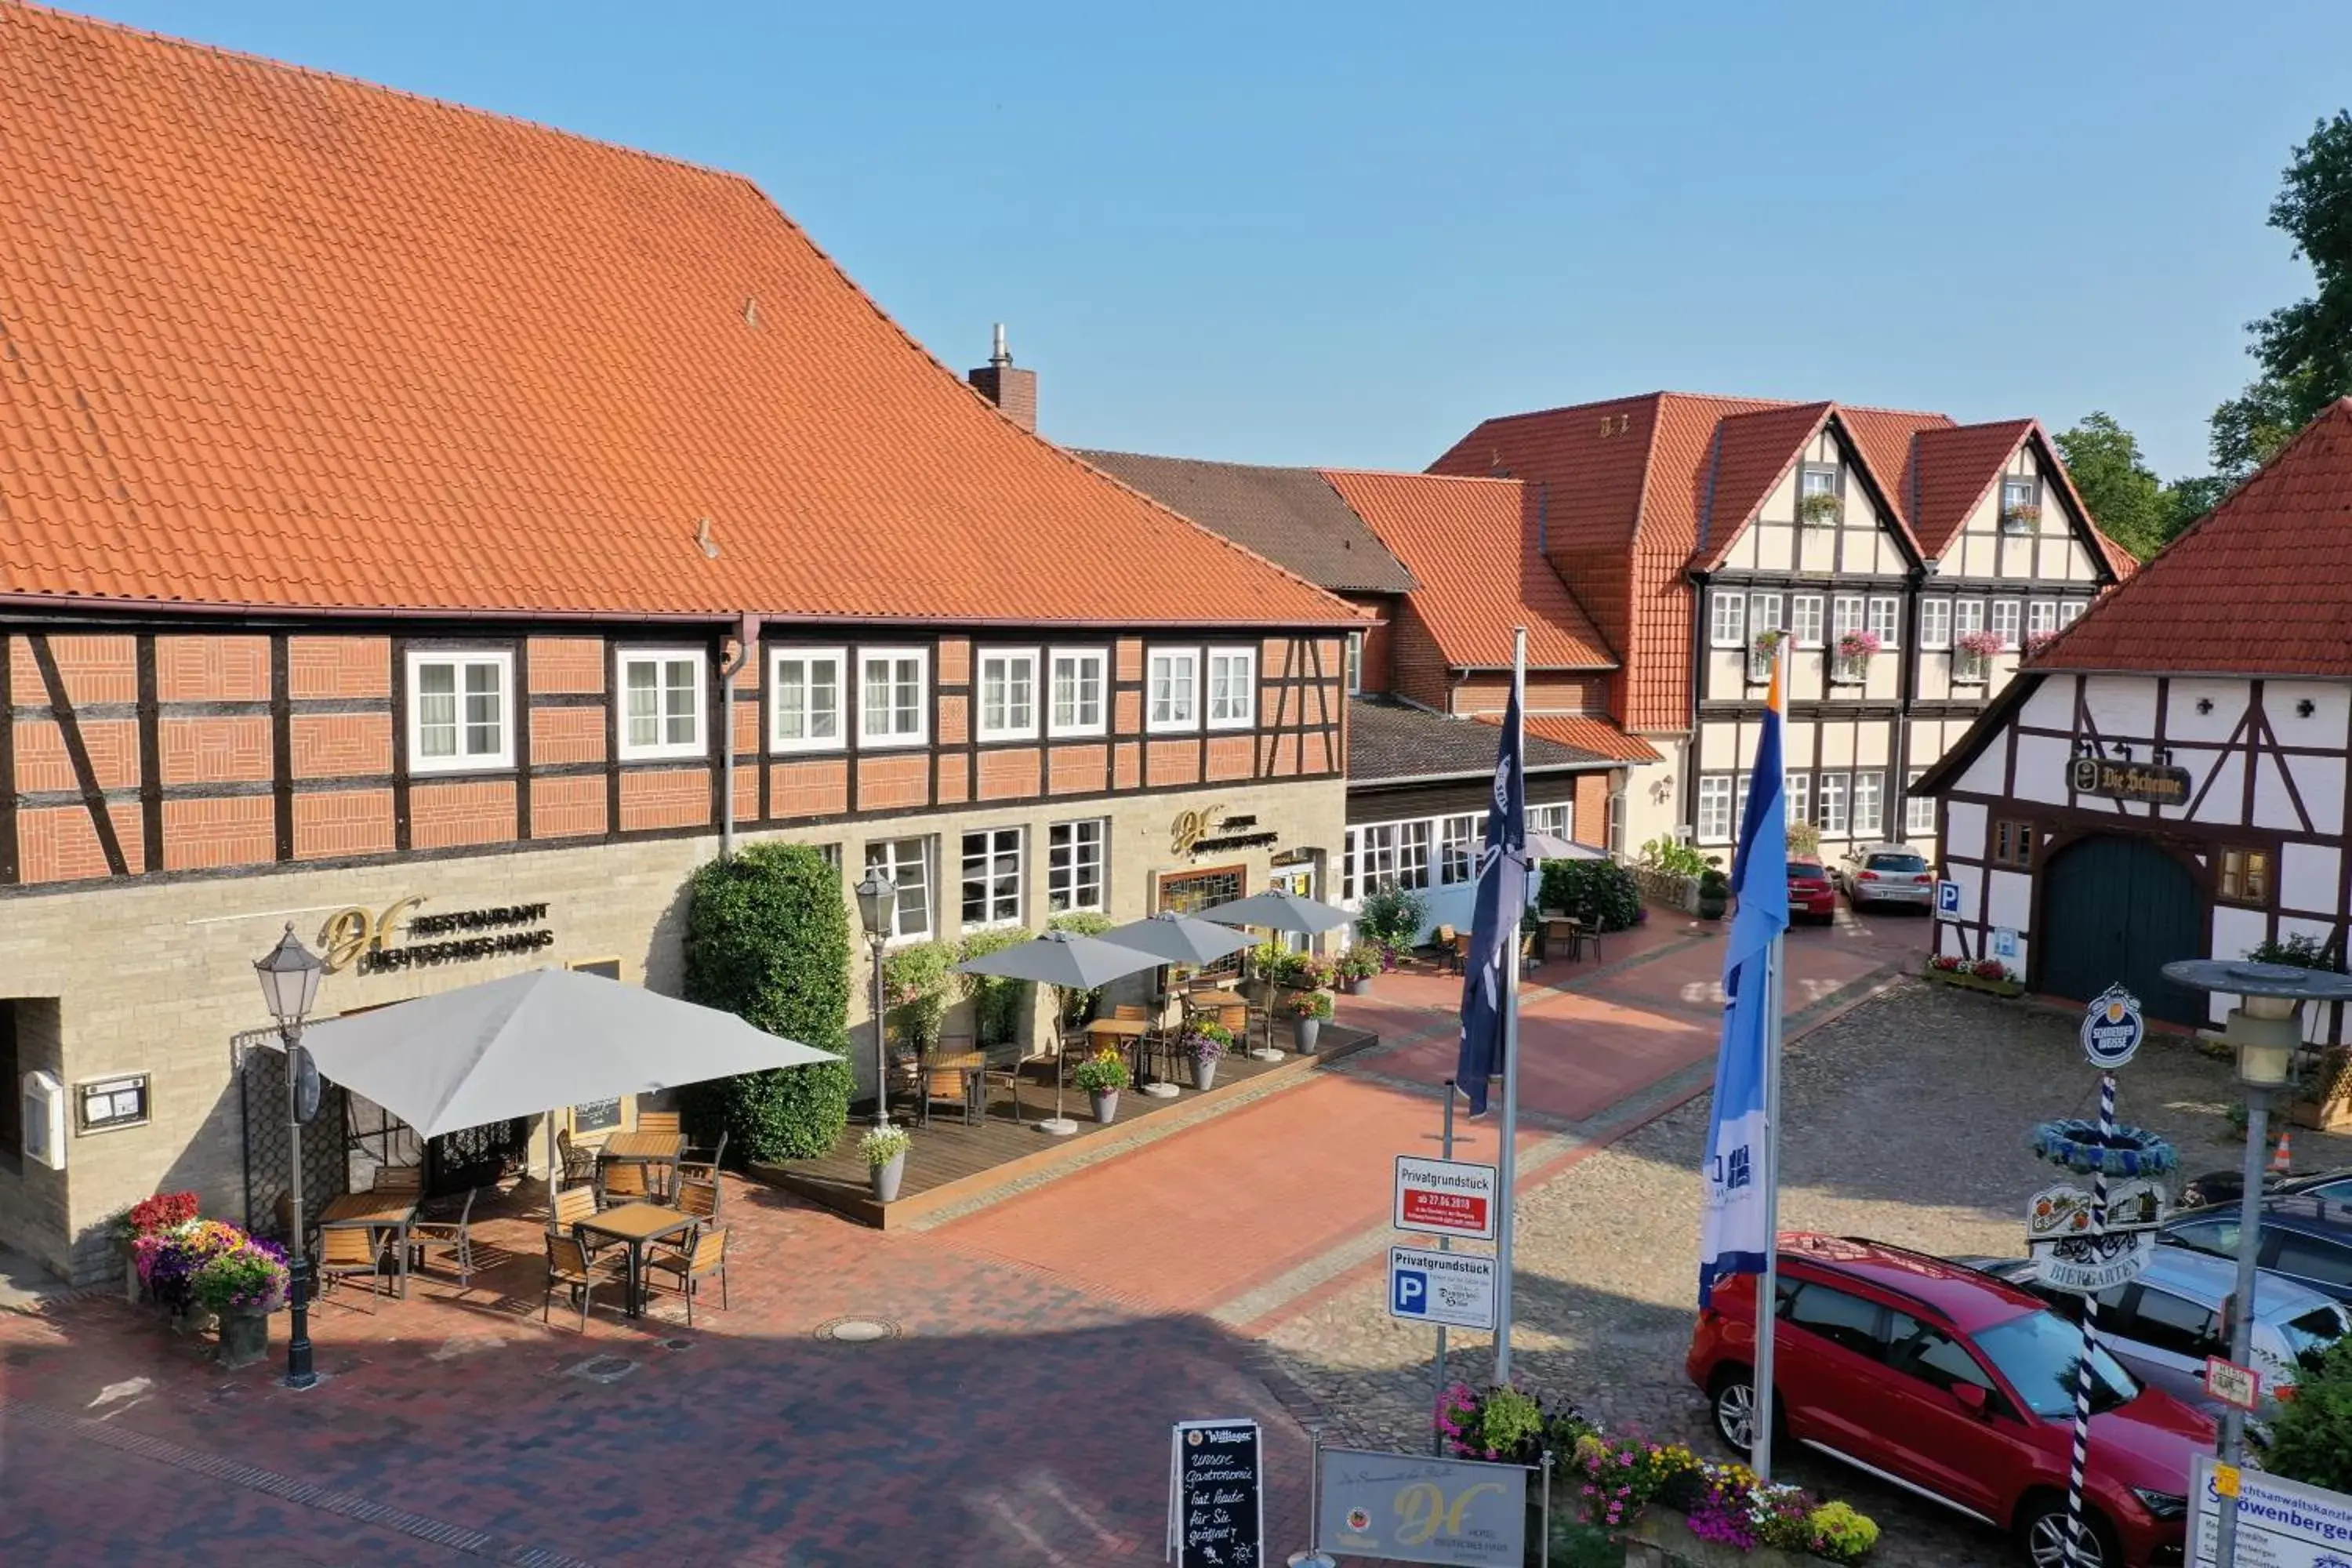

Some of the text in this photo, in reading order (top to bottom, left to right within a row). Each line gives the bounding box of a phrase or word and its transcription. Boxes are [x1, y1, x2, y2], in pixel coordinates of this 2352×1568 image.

[1943, 886, 1956, 908] P
[411, 903, 550, 935] RESTAURANT
[370, 930, 554, 968] DEUTSCHES HAUS
[2092, 1025, 2135, 1039] SCHNEIDER
[2098, 1037, 2127, 1050] WEISSE
[1401, 1167, 1490, 1190] Privatgrundstück
[1395, 1252, 1490, 1274] Privatgrundstück
[2049, 1256, 2143, 1286] BIERGARTEN
[1399, 1276, 1423, 1305] P
[1213, 1508, 1232, 1524] Sie
[2240, 1485, 2352, 1523] chtsanwaltskanzle
[2238, 1496, 2352, 1540] öwenberge
